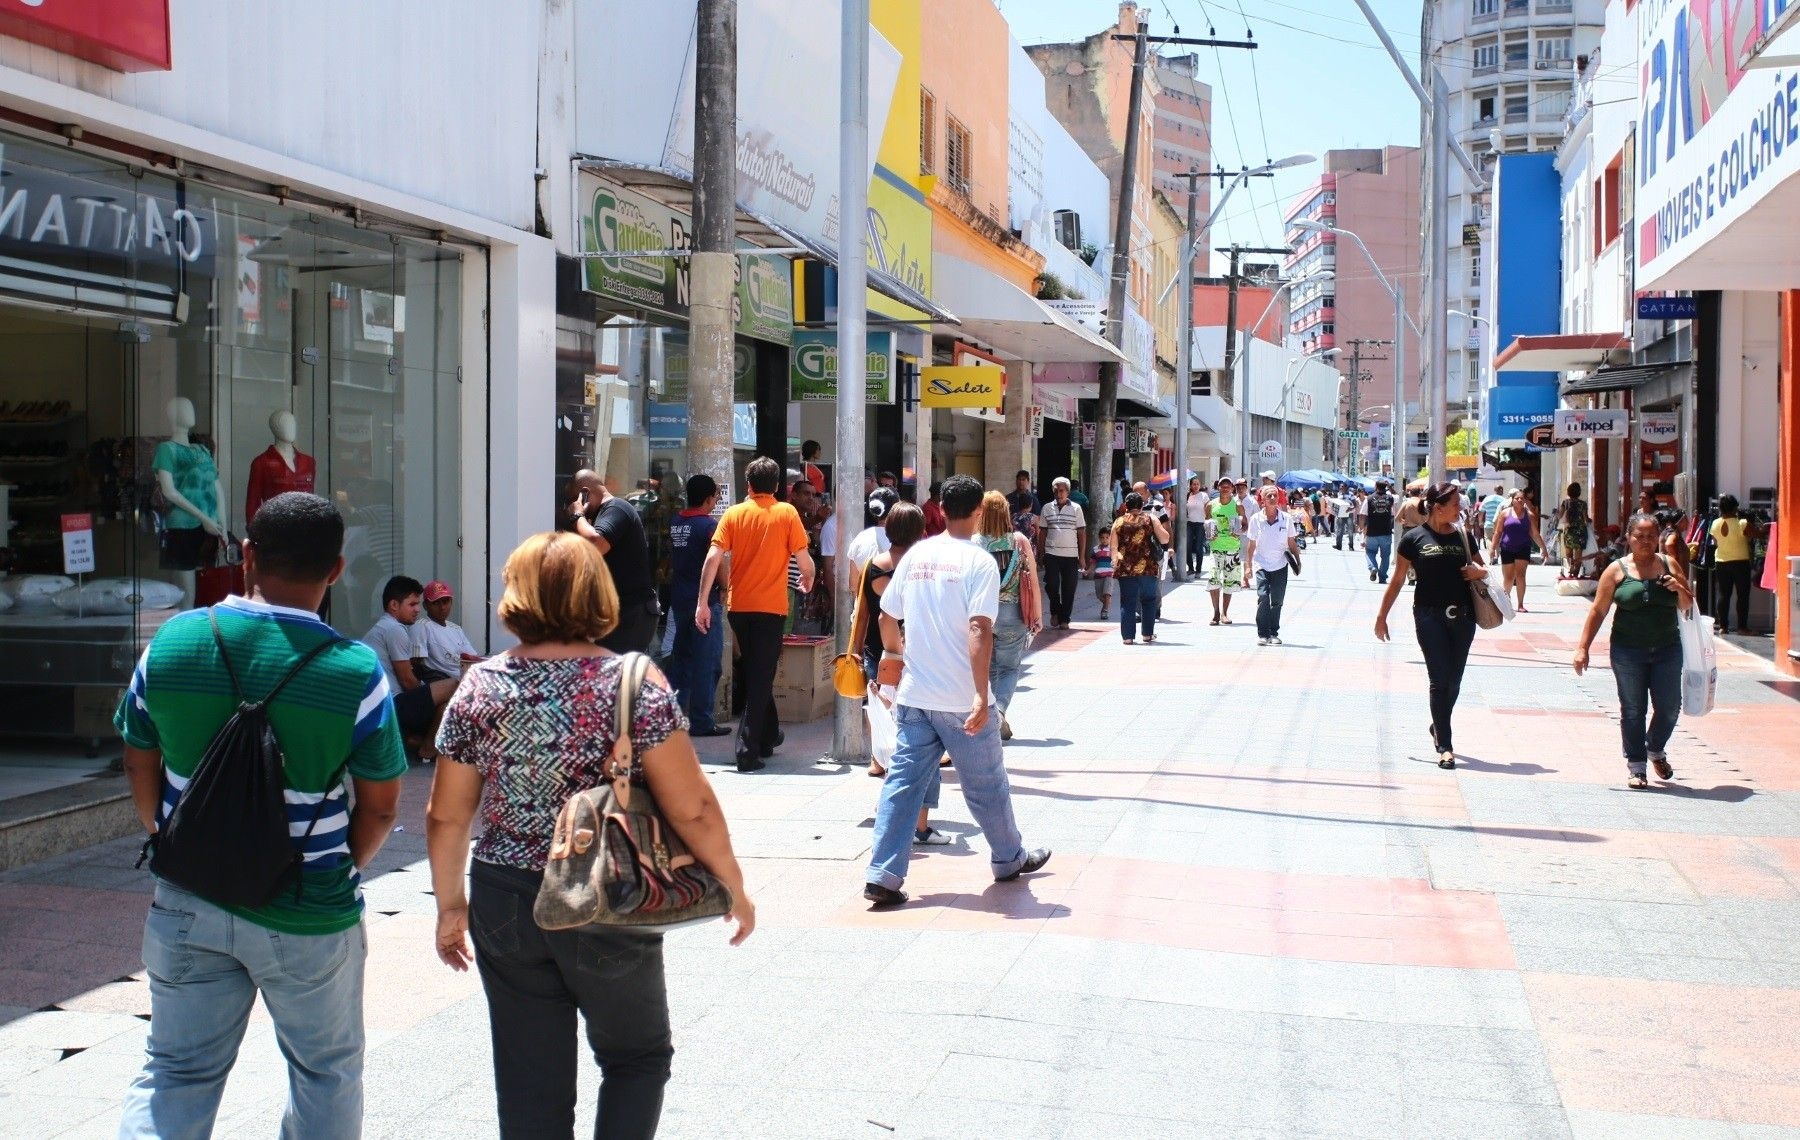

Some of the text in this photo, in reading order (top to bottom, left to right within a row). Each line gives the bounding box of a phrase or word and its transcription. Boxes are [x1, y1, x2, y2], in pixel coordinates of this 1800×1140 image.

[1657, 175, 1702, 257] MÓVEIS
[1706, 163, 1715, 220] E
[1640, 304, 1695, 313] CATTAN
[927, 379, 992, 395] Salete
[1503, 415, 1553, 423] 3311-9055
